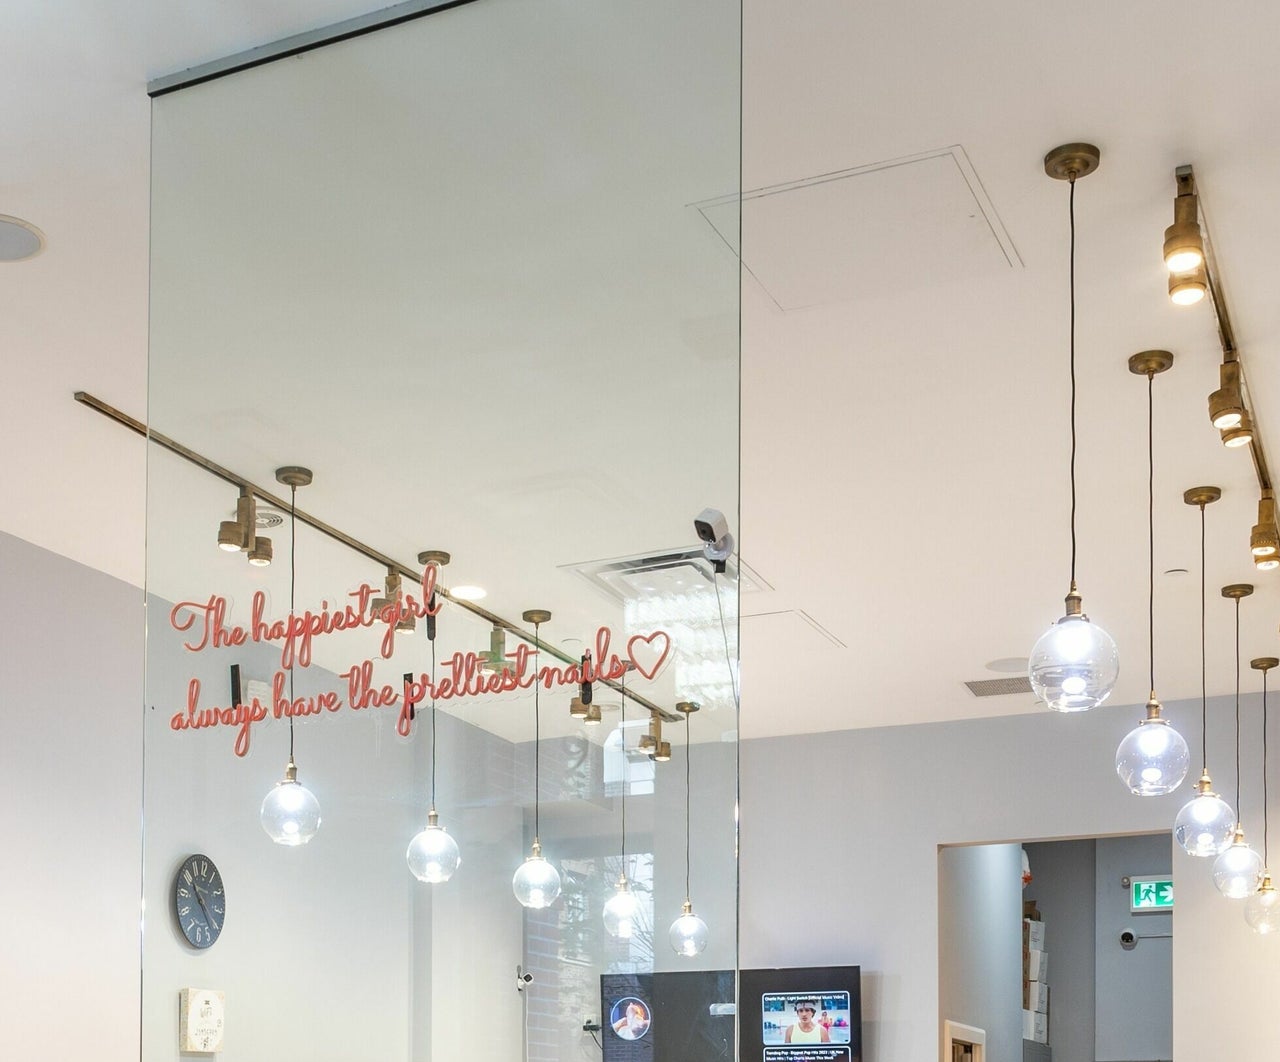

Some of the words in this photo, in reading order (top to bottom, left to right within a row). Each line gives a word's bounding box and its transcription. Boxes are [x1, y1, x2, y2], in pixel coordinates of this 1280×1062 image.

[170, 594, 247, 652] The
[252, 583, 381, 670] happiest
[376, 562, 443, 660] girl
[170, 678, 268, 757] always
[273, 672, 341, 720] have
[339, 662, 395, 710] the
[396, 642, 540, 737] prettiest
[536, 626, 630, 687] nails
[200, 860, 208, 878] 12
